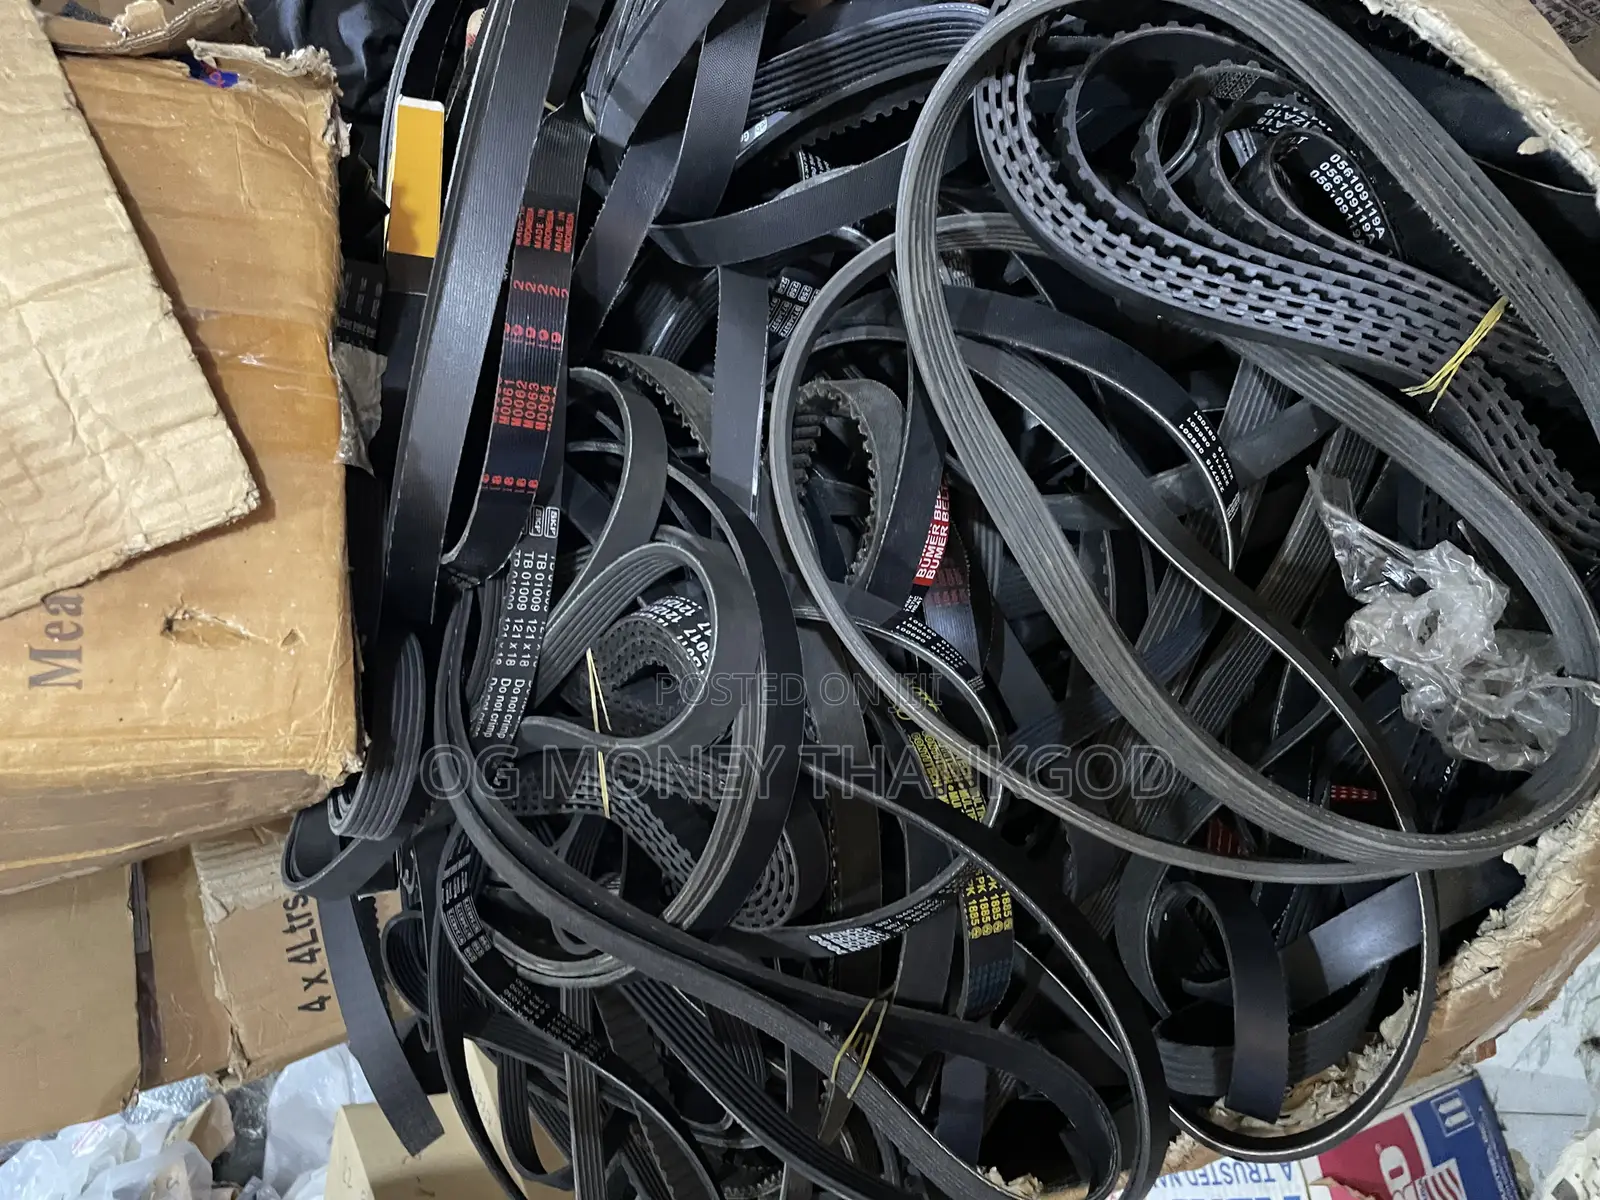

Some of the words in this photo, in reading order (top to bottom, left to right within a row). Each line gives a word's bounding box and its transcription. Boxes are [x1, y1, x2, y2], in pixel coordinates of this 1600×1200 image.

[1319, 162, 1375, 245] 056109119A
[1330, 153, 1386, 240] 056109119A
[534, 222, 544, 249] MADE
[554, 225, 565, 252] MADE
[498, 379, 516, 425] M0061
[510, 380, 528, 427] M0062
[522, 382, 540, 429] M0063
[535, 384, 552, 431] M0064
[534, 508, 542, 534] SKF
[549, 510, 558, 536] SKF
[523, 550, 535, 569] TB
[535, 552, 548, 570] TB
[916, 523, 941, 579] BUMER
[925, 525, 949, 580] BUMER
[517, 571, 532, 611] 01009
[530, 572, 545, 612] 01009
[511, 617, 524, 639] 121
[525, 618, 538, 640] 121
[498, 677, 512, 694] Do
[512, 678, 526, 695] Do
[492, 694, 505, 712] not
[506, 695, 519, 713] not
[482, 712, 499, 738] crimp
[496, 713, 513, 739] crimp
[968, 899, 980, 927] 1885
[979, 895, 991, 924] 1885
[990, 893, 1002, 921] 1885
[1001, 890, 1012, 918] 1885
[297, 994, 332, 1012] 4
[1186, 1162, 1277, 1186] TRUSTED
[1280, 1162, 1293, 1181] A
